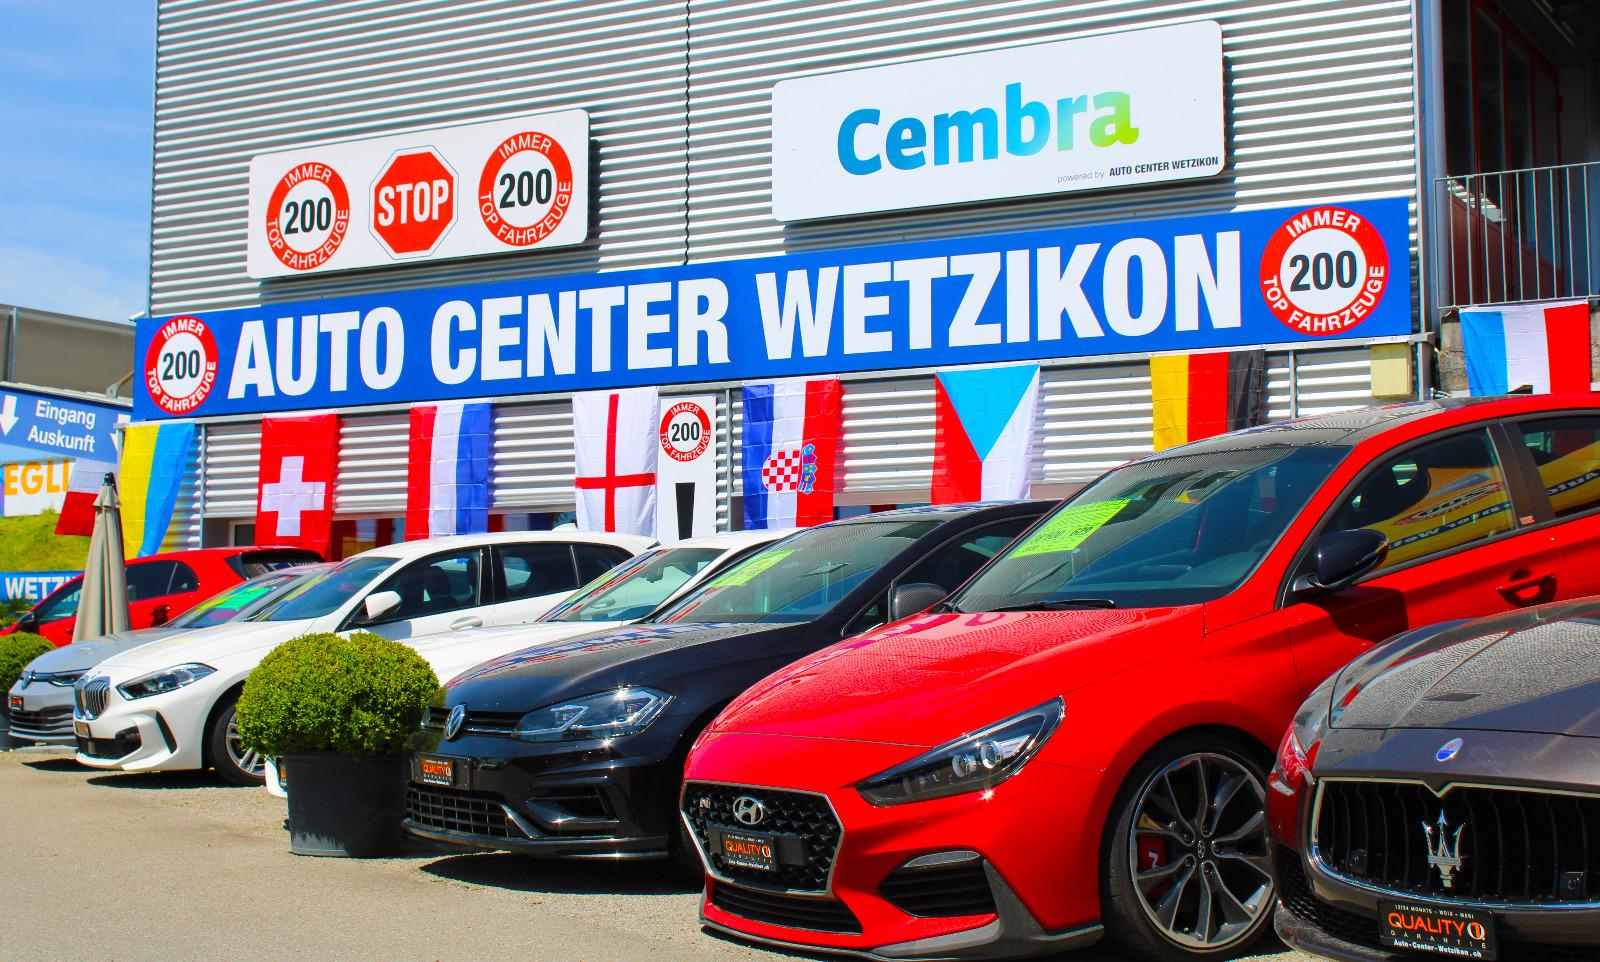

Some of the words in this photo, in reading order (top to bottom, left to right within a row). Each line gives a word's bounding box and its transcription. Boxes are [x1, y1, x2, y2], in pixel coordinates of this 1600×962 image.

[837, 82, 1139, 175] Cembra
[499, 133, 553, 160] IMMER
[284, 164, 332, 188] IMMER
[1057, 171, 1093, 184] powered
[1094, 170, 1105, 180] by
[1109, 165, 1132, 177] AUTO
[1135, 162, 1169, 174] CENTER
[1171, 156, 1219, 170] WETZIKON
[378, 178, 449, 227] STOP
[499, 168, 553, 209] 200
[284, 197, 332, 235] 200
[479, 190, 499, 225] TOP
[497, 181, 571, 244] FAHRZEUGE
[1285, 210, 1361, 238] IMMER
[267, 218, 285, 251] TOP
[282, 209, 349, 268] FAHRZEUGE
[1289, 250, 1357, 292] 200
[227, 306, 405, 399] AUTO
[430, 277, 732, 386] CENTER
[755, 230, 1242, 360] WETZIKON
[1263, 275, 1289, 312] TOP
[1287, 265, 1385, 332] FAHRZEUGE
[162, 319, 205, 340] IMMER
[162, 349, 200, 381] 200
[147, 368, 162, 395] TOP
[160, 361, 216, 411] FAHRZEUGE
[35, 399, 96, 430] Eingang
[670, 403, 700, 416] IMMER
[27, 425, 96, 453] Auskunft
[660, 432, 671, 450] TOP
[670, 429, 711, 461] FAHRZEUGE
[671, 421, 700, 442] 200
[4, 459, 70, 496] EGLI
[725, 840, 762, 858] QUALITY
[1388, 912, 1466, 938] QUALITY
